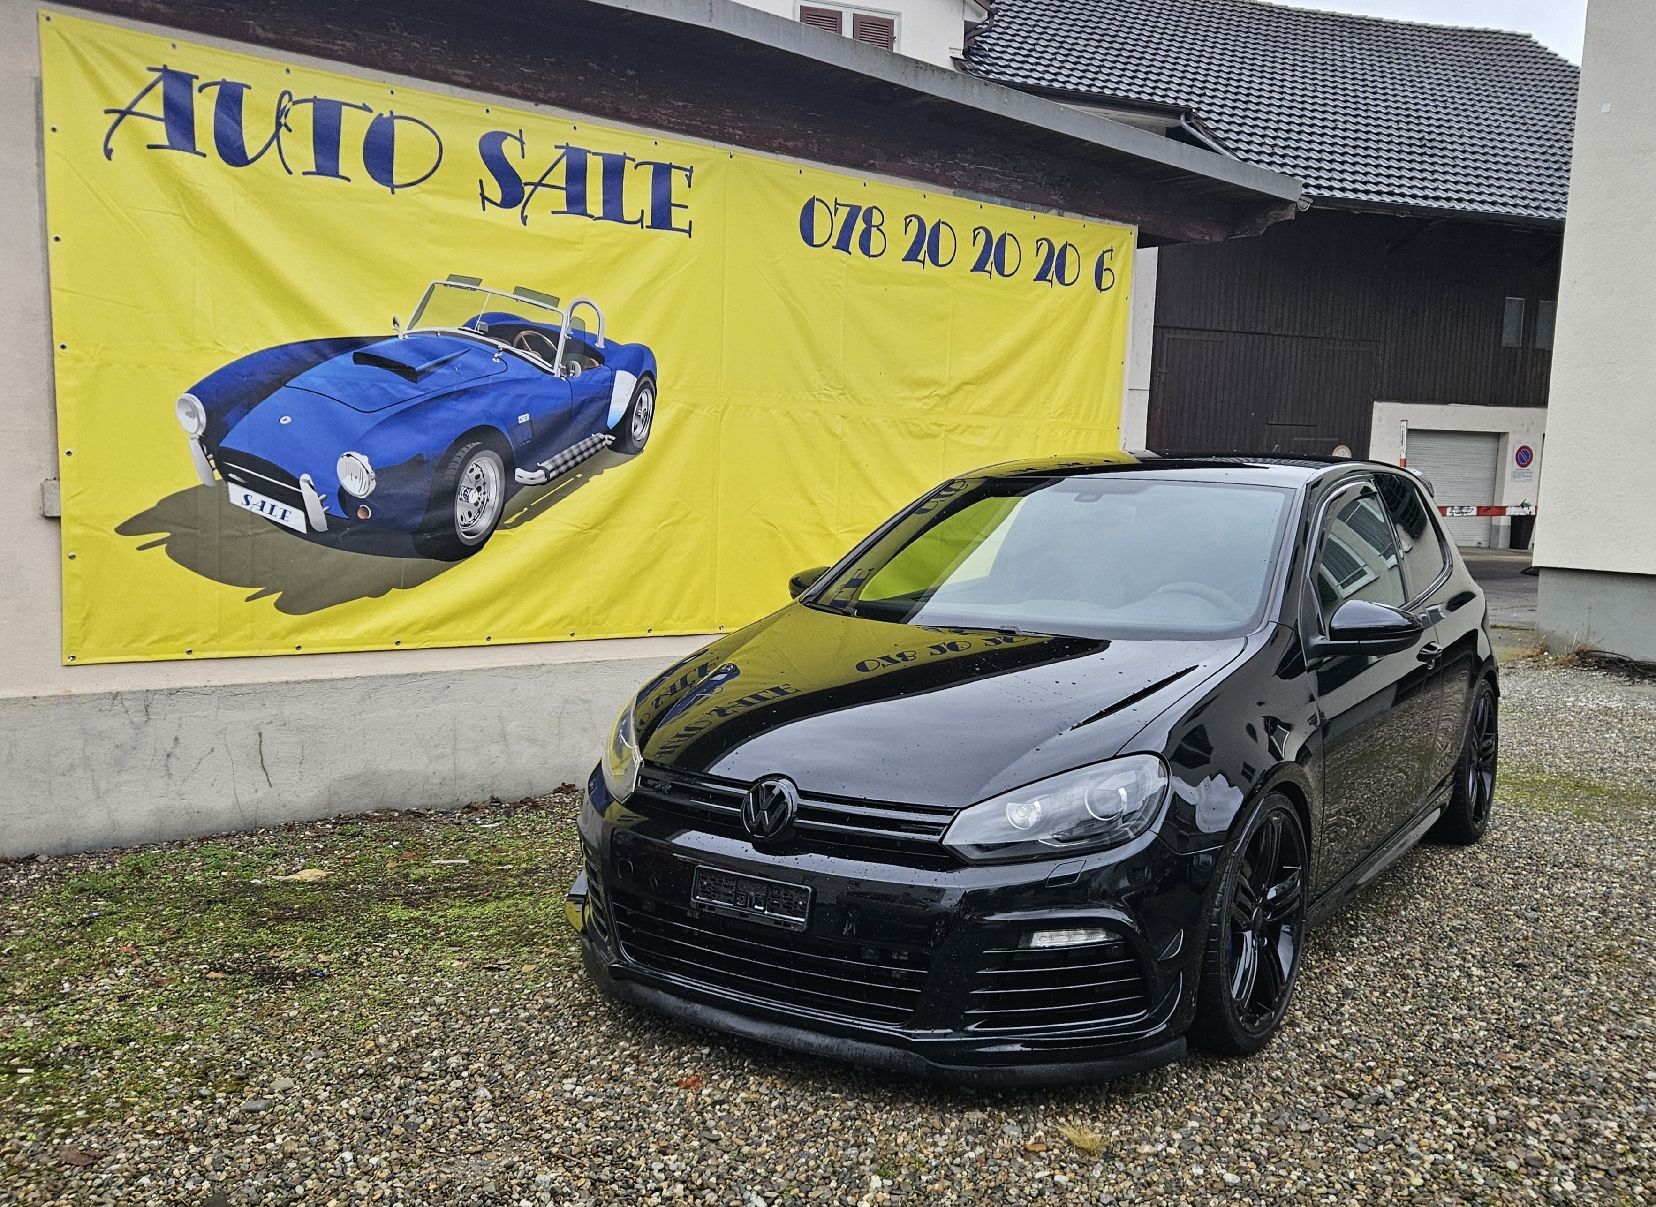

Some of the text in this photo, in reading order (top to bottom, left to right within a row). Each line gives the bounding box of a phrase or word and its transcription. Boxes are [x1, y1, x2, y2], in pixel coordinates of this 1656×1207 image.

[104, 64, 694, 238] AUTO SALE
[800, 195, 1115, 293] 078 20 20 20 6
[241, 494, 291, 522] SALE
